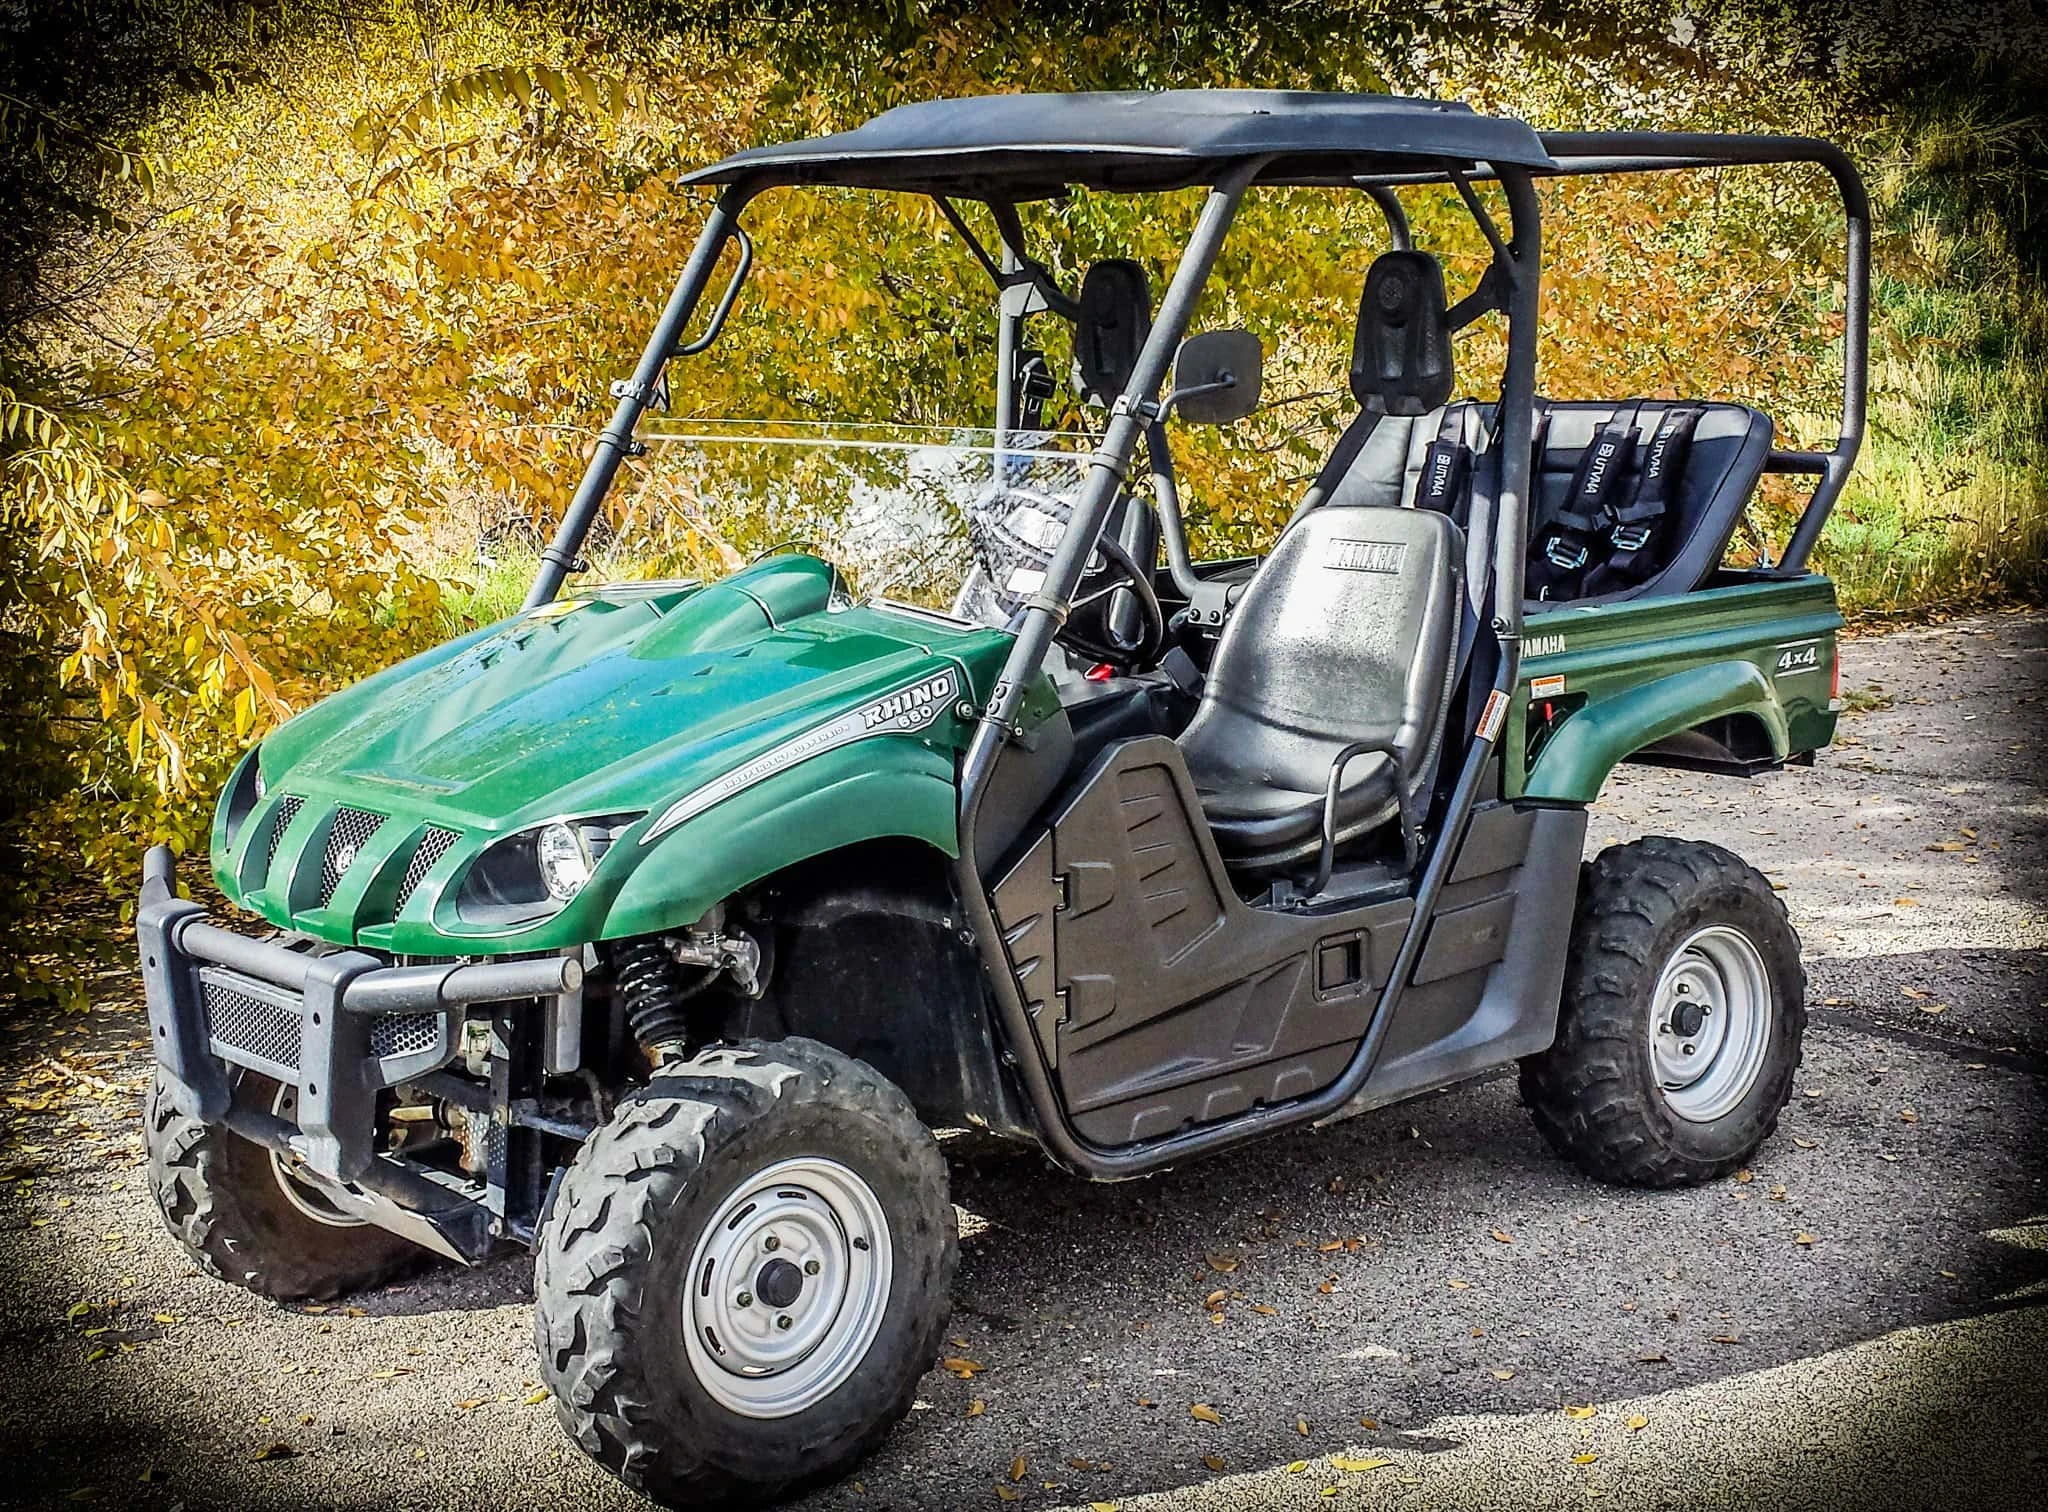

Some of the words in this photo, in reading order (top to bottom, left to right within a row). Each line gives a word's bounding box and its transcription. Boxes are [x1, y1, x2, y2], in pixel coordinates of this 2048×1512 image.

[1584, 458, 1608, 494] UTVMA
[1328, 542, 1402, 571] AMAHA
[1778, 647, 1816, 669] 4x4
[861, 676, 950, 729] RHINO
[897, 704, 932, 729] 660
